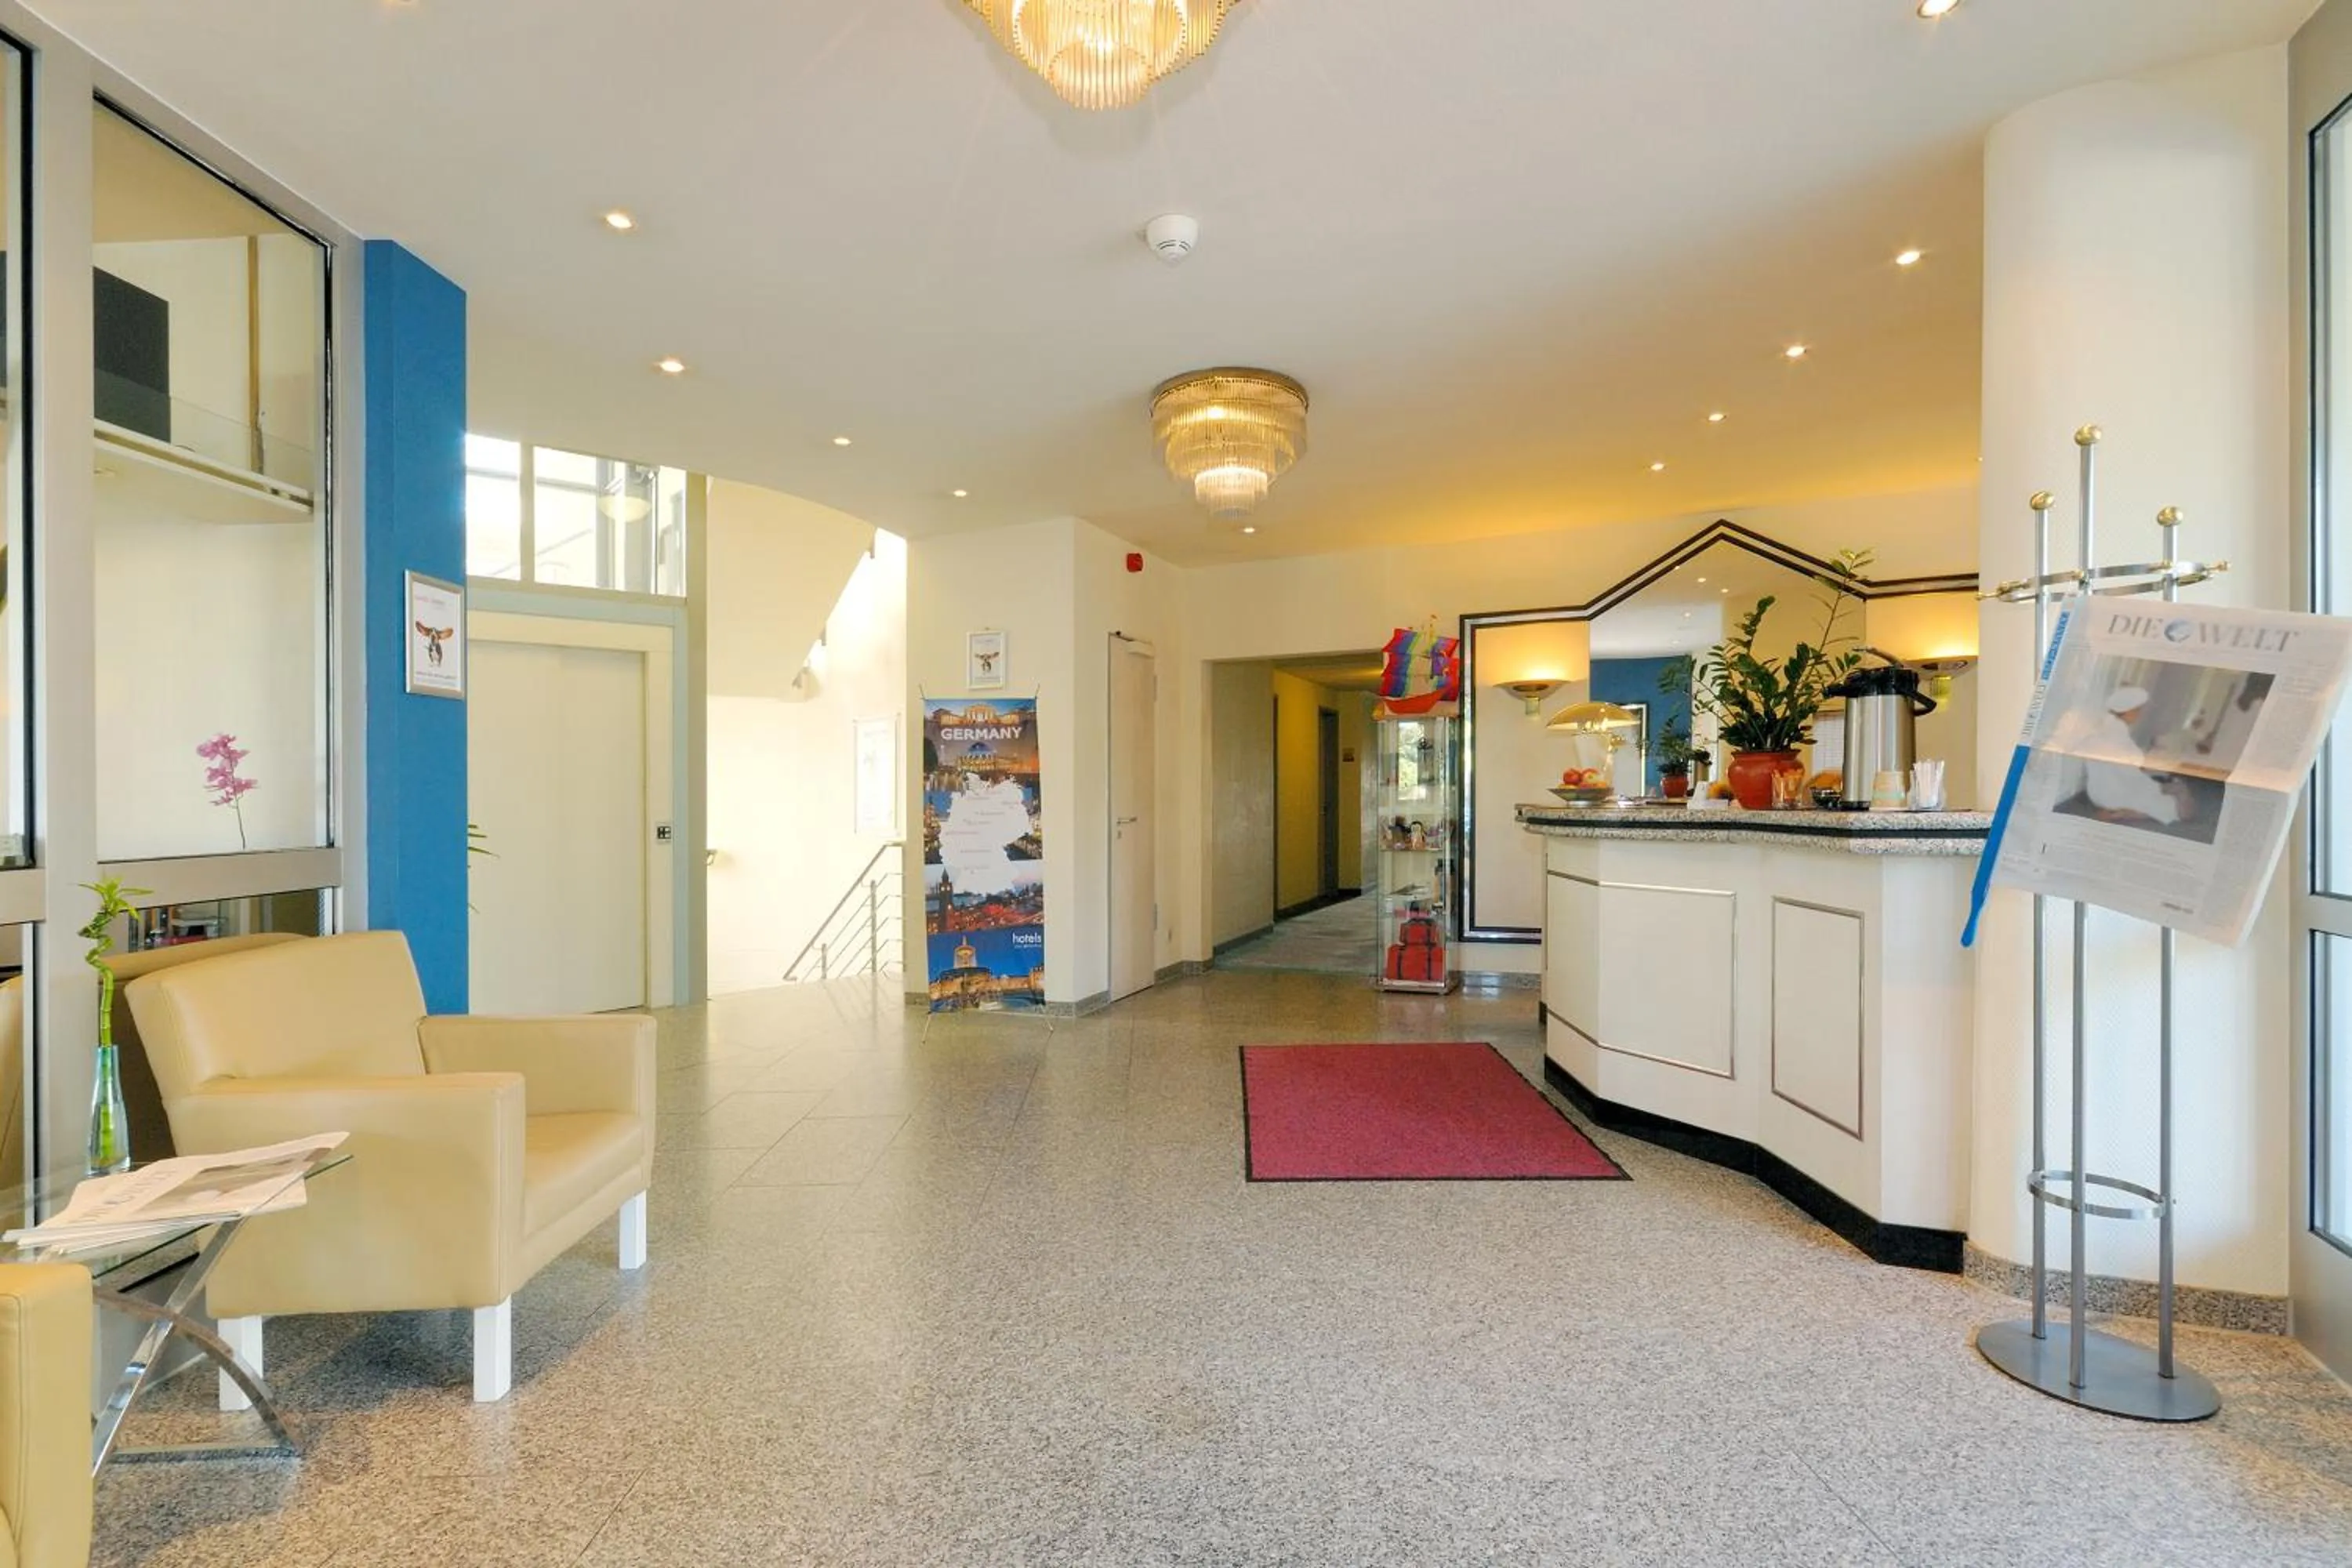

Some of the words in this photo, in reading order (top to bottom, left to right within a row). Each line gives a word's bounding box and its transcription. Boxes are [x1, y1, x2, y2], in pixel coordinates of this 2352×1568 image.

[2107, 613, 2164, 640] DIE
[2198, 621, 2301, 652] WELT
[941, 727, 1022, 741] GERMANY
[1012, 932, 1042, 944] hotels
